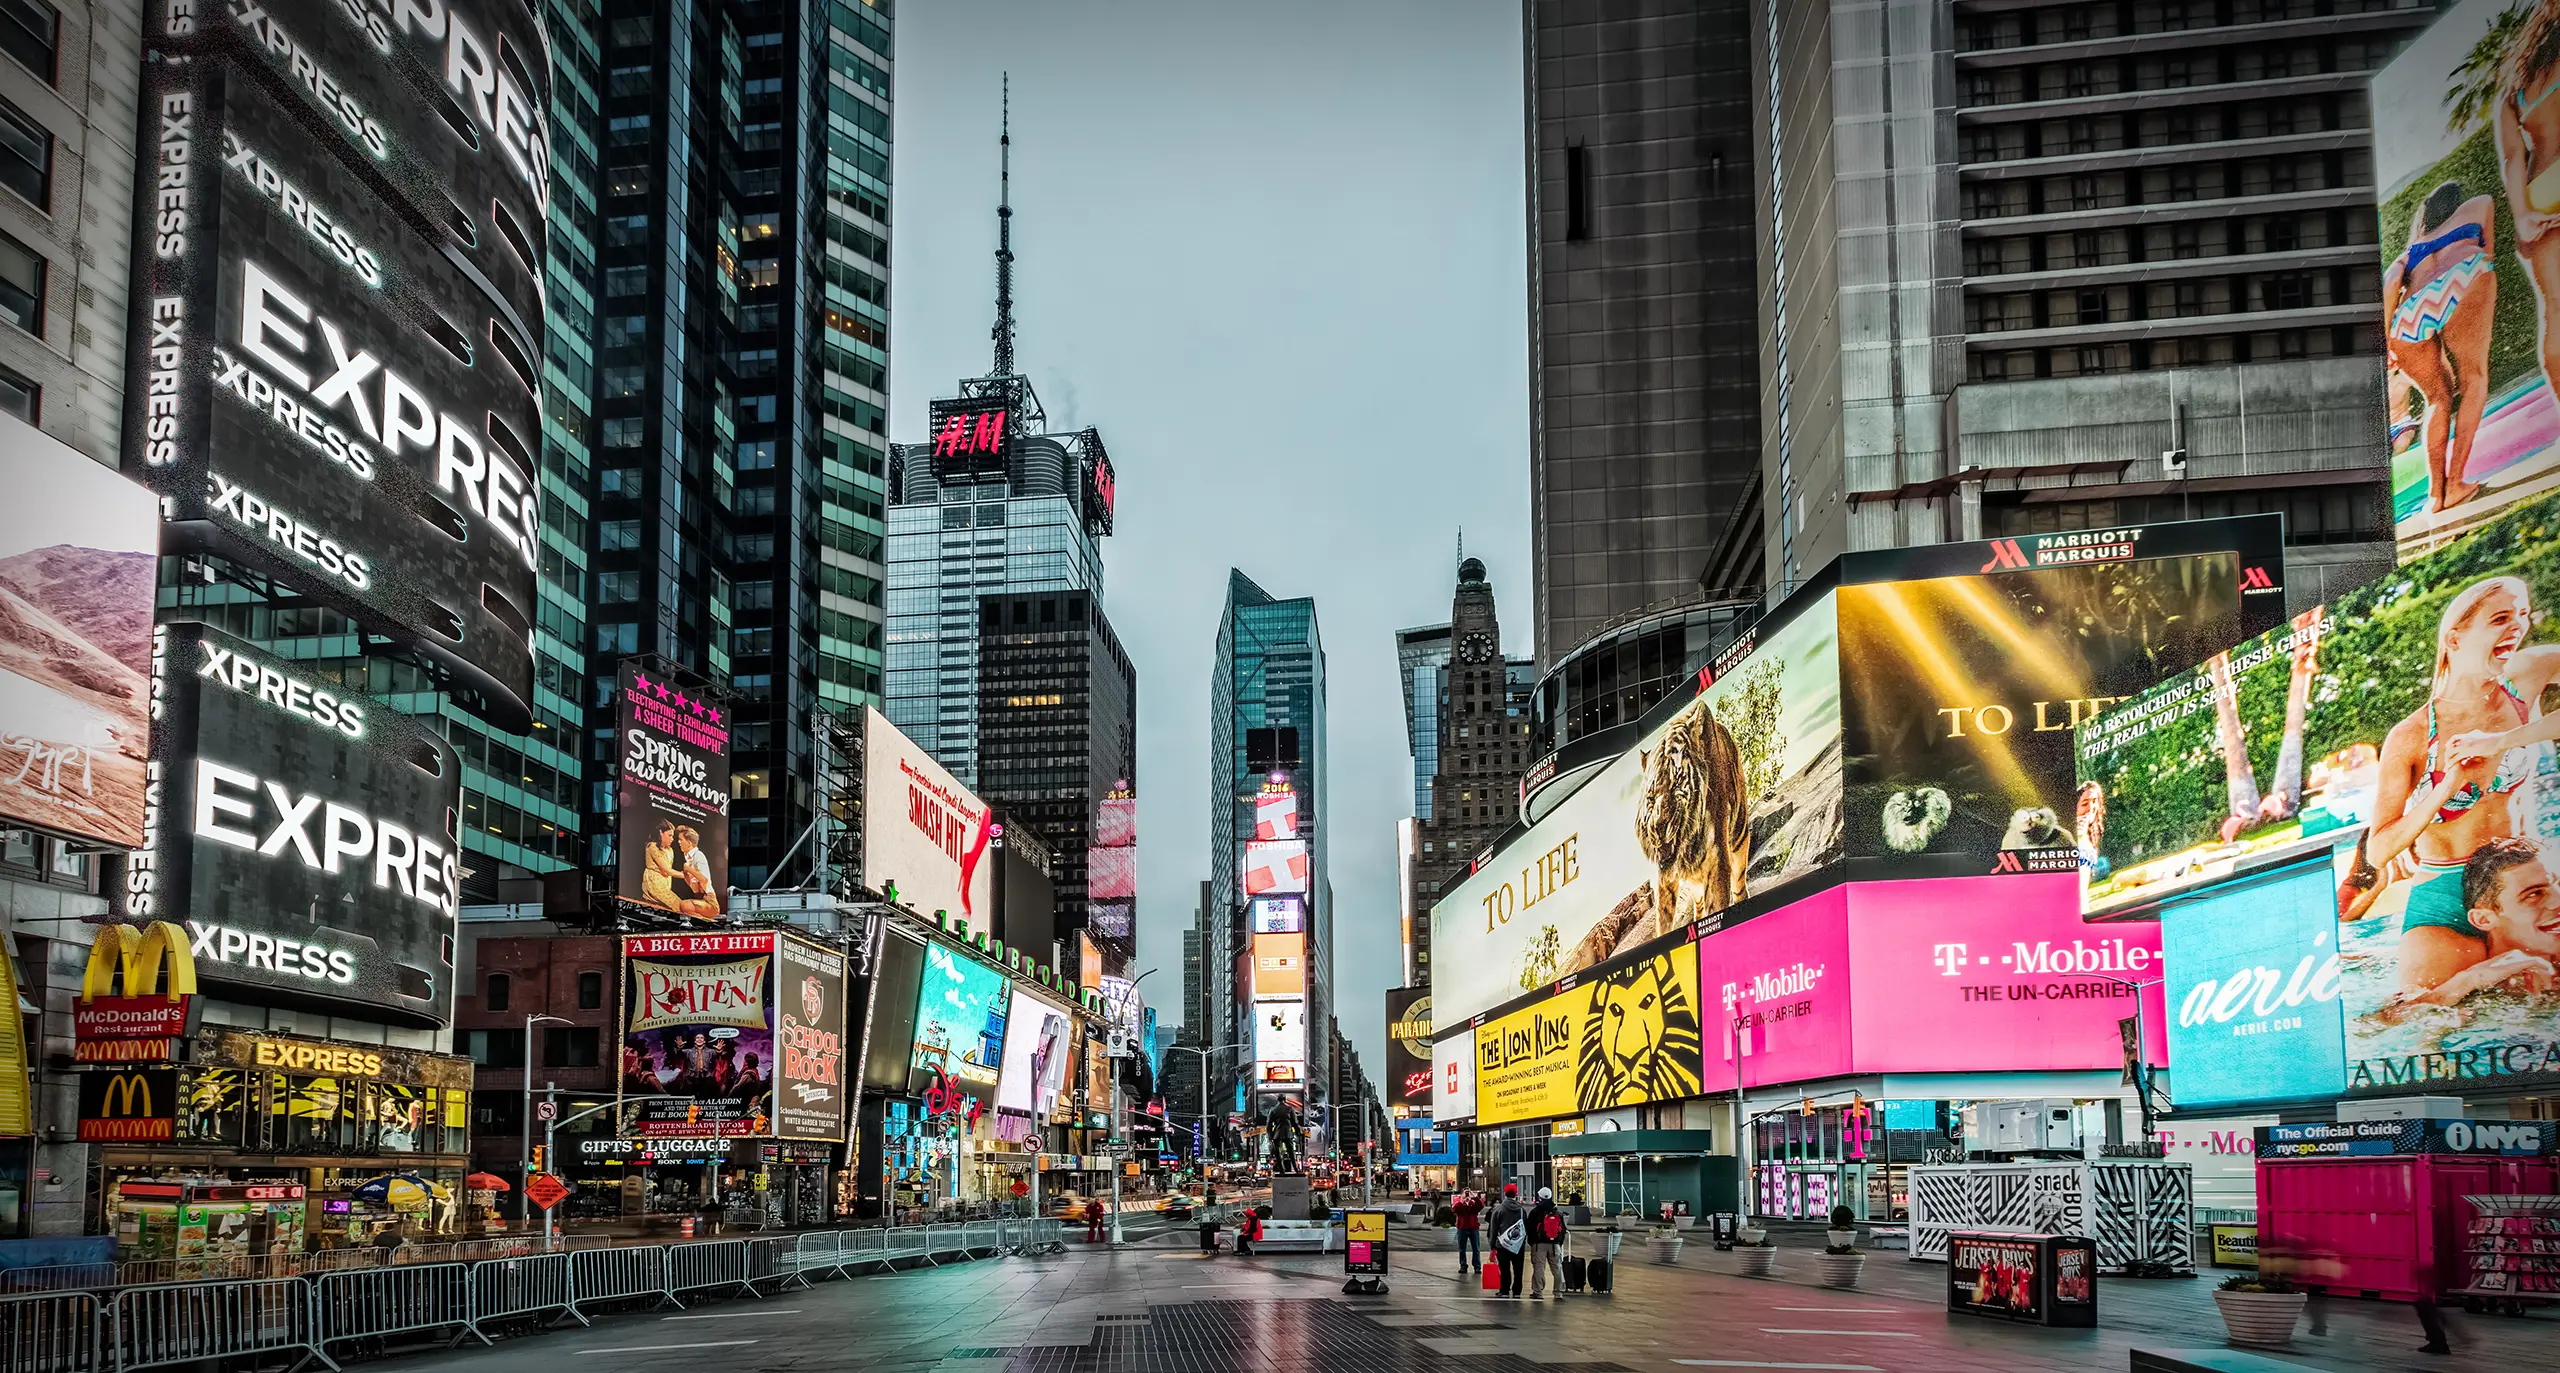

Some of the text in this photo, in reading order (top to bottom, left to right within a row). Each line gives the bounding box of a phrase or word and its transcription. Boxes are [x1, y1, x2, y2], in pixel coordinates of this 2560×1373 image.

[227, 0, 388, 160] XPRESS
[156, 91, 192, 259] EXPRESS
[223, 127, 381, 289] XPRESS
[147, 297, 182, 466] EXPRESS
[213, 347, 375, 482] XPRESS
[935, 411, 1005, 457] H&M
[207, 471, 370, 590] XPRESS
[2038, 528, 2143, 550] MARRIOTT
[2037, 544, 2132, 564] MARQUIS
[2244, 587, 2283, 595] MARRIOTT
[1715, 627, 1757, 667] MARRIOTT
[1715, 644, 1753, 679] MARQUIS
[2083, 616, 2337, 744] NO RETOUCHING ON THESE GIRLS!
[634, 705, 674, 735] A SHEER
[1938, 704, 2014, 738] TO
[2083, 740, 2110, 760] THE
[2111, 722, 2149, 748] REAL
[2149, 707, 2179, 730] YOU
[2182, 699, 2198, 716] IS
[628, 729, 706, 781] SPRING
[624, 757, 731, 816] awakening
[1264, 784, 1290, 793] 2016
[194, 759, 456, 919] EXPRES
[908, 783, 966, 868] SMASH HIT
[989, 839, 1002, 848] LG
[1250, 842, 1304, 850] TOSHIBA
[1482, 831, 1580, 934] TO LIFE
[690, 937, 722, 950] FAT
[783, 950, 794, 962] HAS
[651, 963, 748, 978] SOMETHING
[936, 909, 1107, 1017] 1540 BROADWAY
[1960, 982, 2138, 1001] THE UN-CARRIER
[78, 1007, 181, 1024] McDonald's
[718, 1016, 732, 1024] NEW
[1752, 1000, 1812, 1027] UN-CARRIER
[2233, 1015, 2302, 1037] AERIE.COM
[95, 1024, 162, 1034] Restaurant
[780, 1013, 841, 1056] SCHOOL
[1481, 1013, 1569, 1068] THE LION KING
[256, 1041, 382, 1076] EXPRESS
[785, 1046, 838, 1086] ROCK
[1482, 1059, 1570, 1088] THE AWARD-WINNING BEST MUSICAL
[784, 1117, 835, 1128] WINTER GARDEN THEATRE
[2277, 1122, 2402, 1140] The Official Guide
[581, 1140, 731, 1152] GIFTS LUGGAGE
[2277, 1140, 2349, 1155] nycgo.com
[2475, 1125, 2540, 1150] NYC
[2034, 1169, 2082, 1191] snack
[2063, 1193, 2083, 1230] BOX
[1955, 1246, 2034, 1275] JERSEY BOYS
[2058, 1252, 2085, 1267] JERSEY
[2062, 1266, 2081, 1278] BOYS
